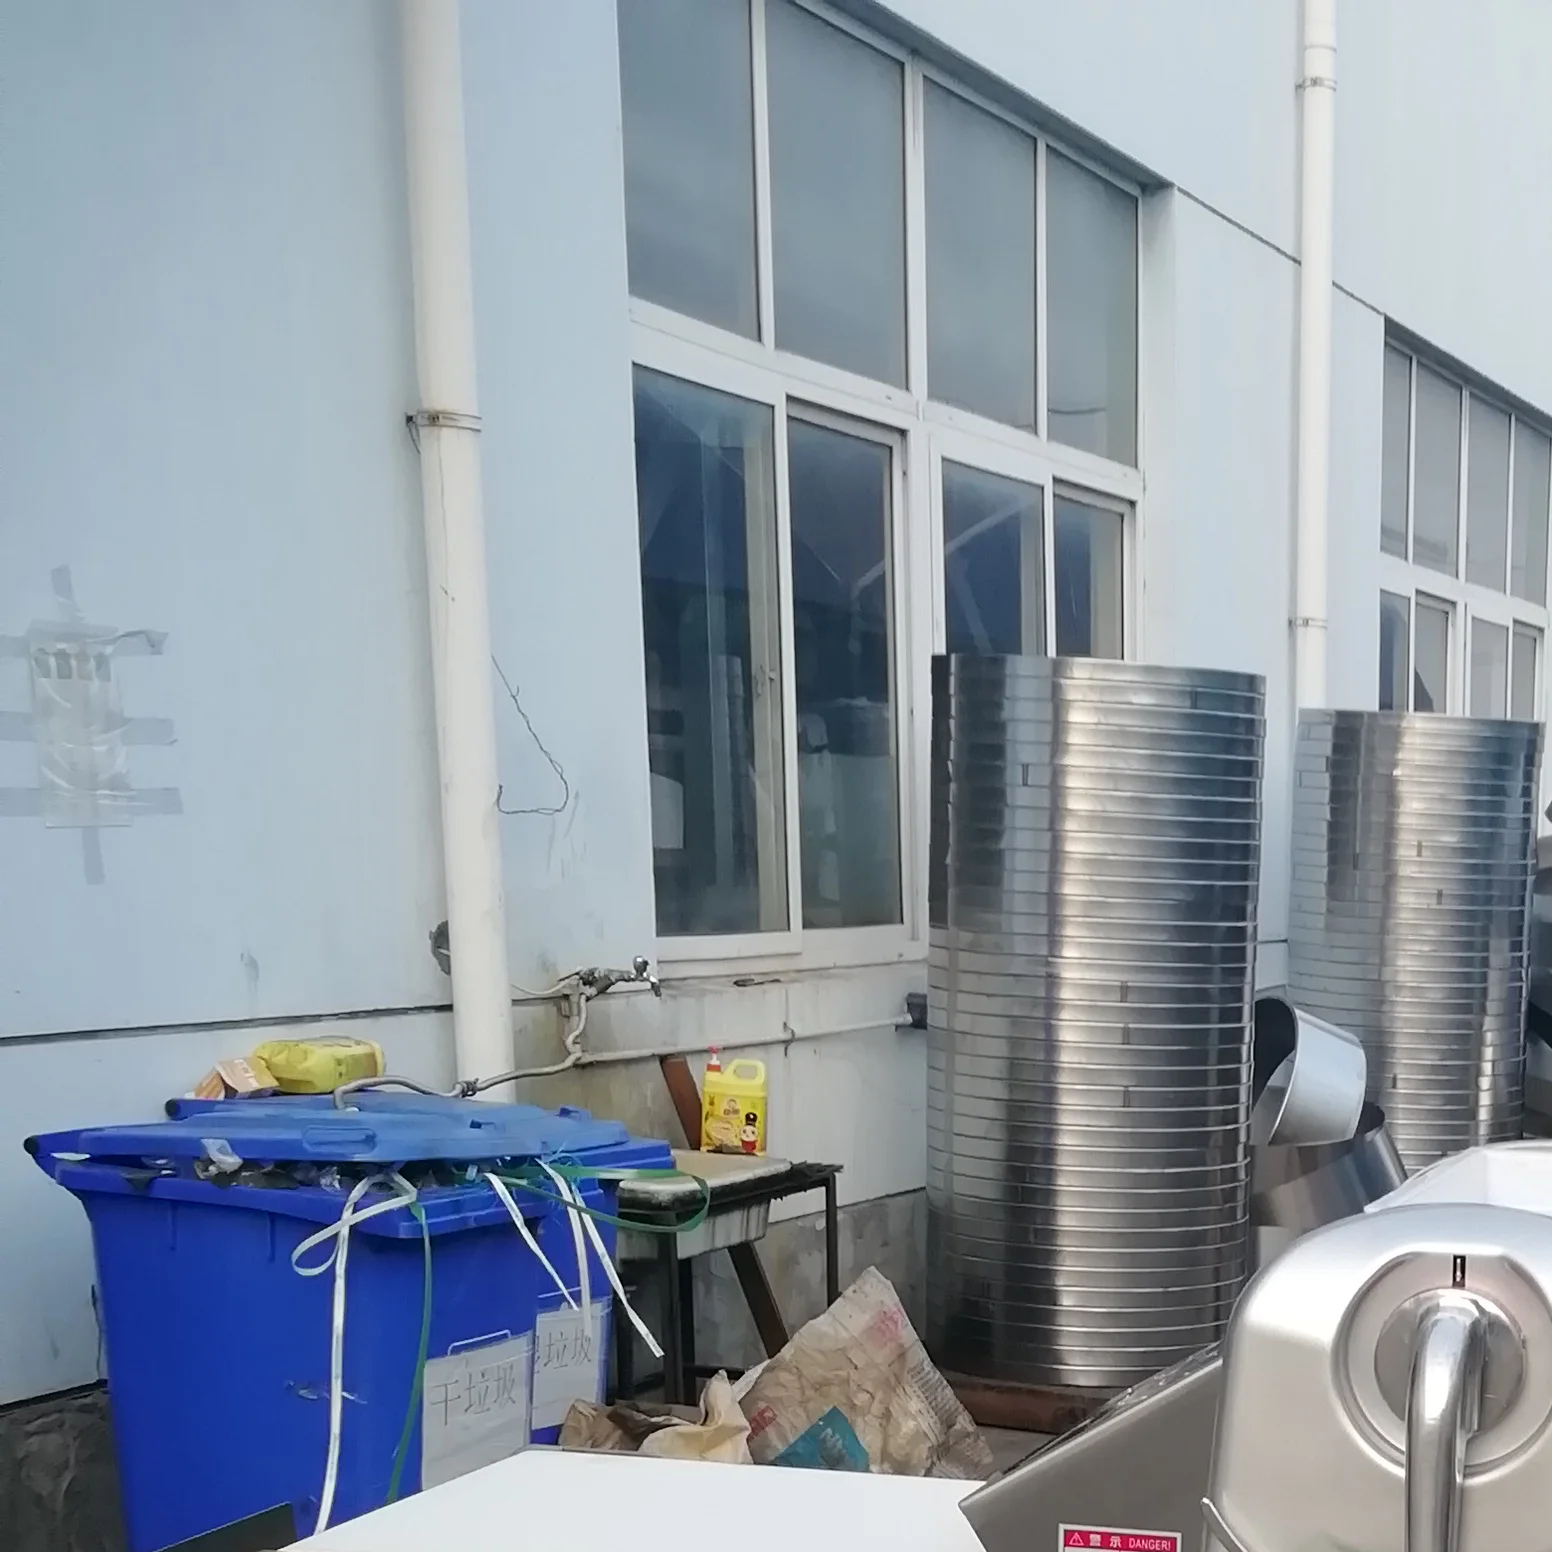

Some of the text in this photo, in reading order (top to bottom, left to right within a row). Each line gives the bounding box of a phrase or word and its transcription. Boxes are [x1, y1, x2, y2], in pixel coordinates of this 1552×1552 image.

[430, 1361, 516, 1427] 干垃圾
[1128, 1537, 1171, 1551] DANGER!
